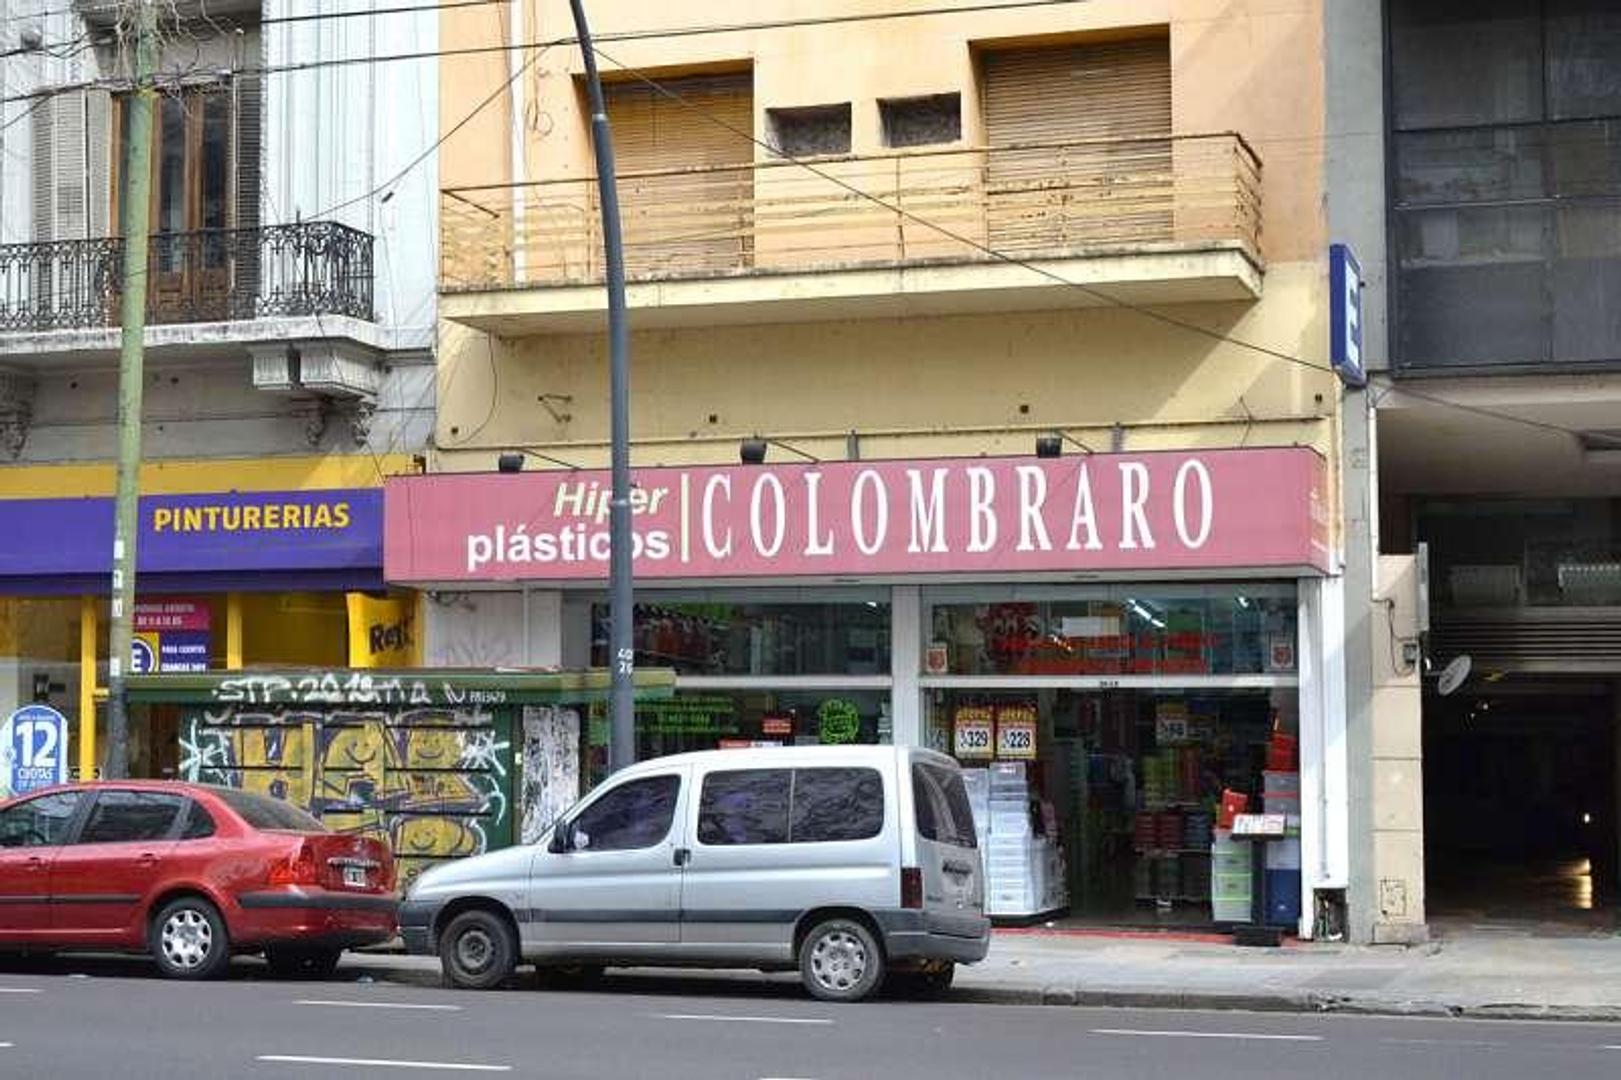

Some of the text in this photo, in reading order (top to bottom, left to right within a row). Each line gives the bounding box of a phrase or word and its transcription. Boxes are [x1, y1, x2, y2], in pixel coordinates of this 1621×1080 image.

[154, 503, 350, 532] PINTURERIAS
[702, 458, 1214, 559] COLOMBRARO
[16, 721, 57, 768] 12
